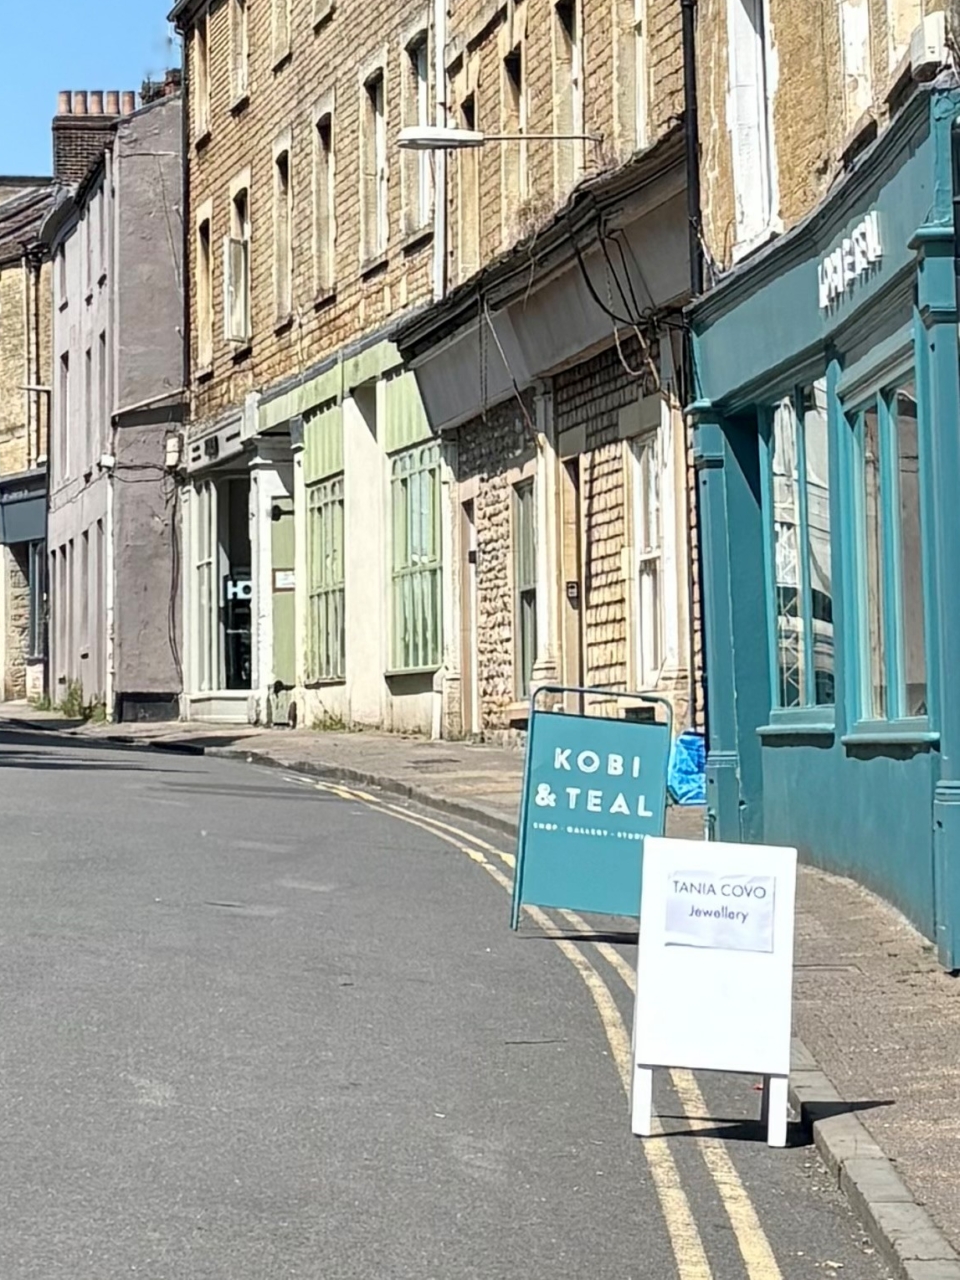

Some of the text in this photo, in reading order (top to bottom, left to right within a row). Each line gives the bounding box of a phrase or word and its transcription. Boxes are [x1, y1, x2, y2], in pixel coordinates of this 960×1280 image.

[554, 747, 640, 778] KOBI
[535, 783, 653, 817] & TEAL
[617, 832, 645, 840] STUDI
[673, 880, 767, 899] TANIA COVO
